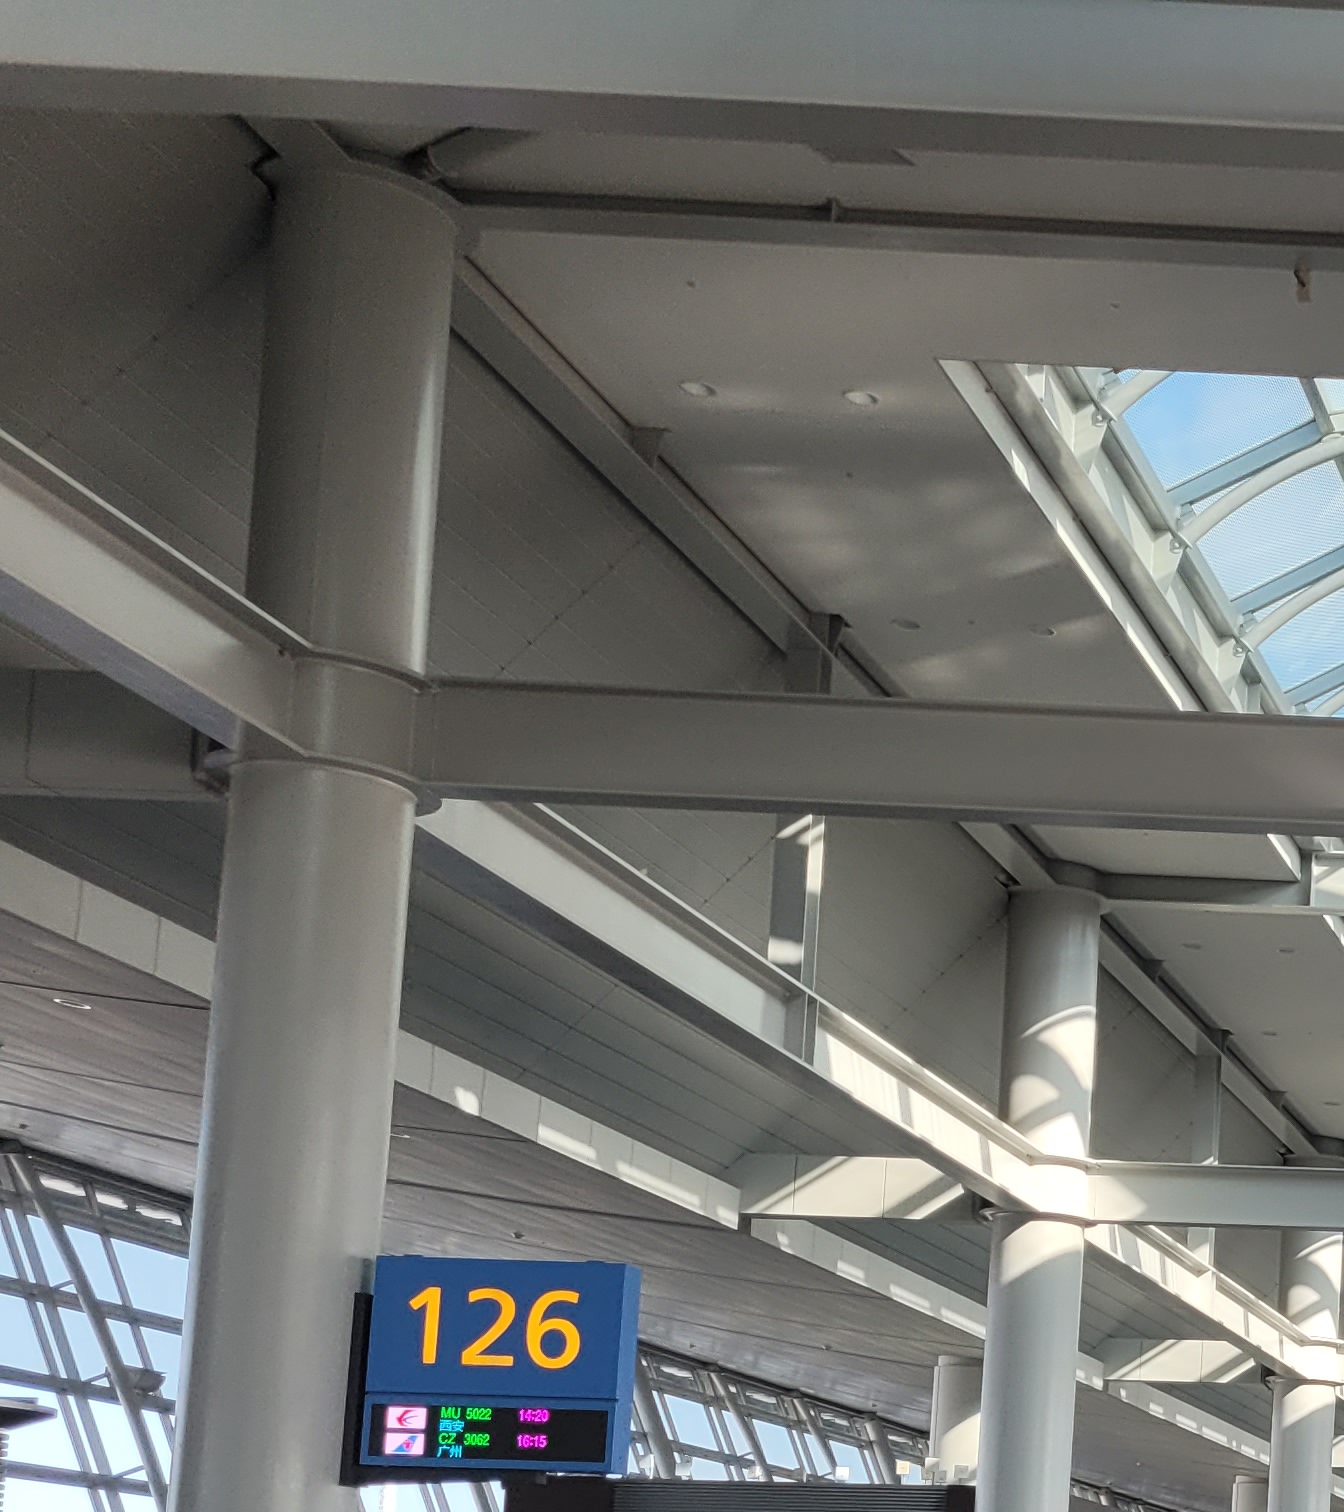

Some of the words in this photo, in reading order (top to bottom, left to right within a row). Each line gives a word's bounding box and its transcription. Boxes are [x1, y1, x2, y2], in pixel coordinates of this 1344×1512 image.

[408, 1286, 581, 1369] 126
[440, 1406, 461, 1419] MU
[465, 1407, 492, 1420] 5022
[519, 1408, 550, 1422] 14:20
[439, 1419, 465, 1432] 西安
[438, 1432, 456, 1445] CZ
[463, 1433, 490, 1447] 3062
[517, 1434, 548, 1448] 16:15
[436, 1445, 462, 1458] 广州
